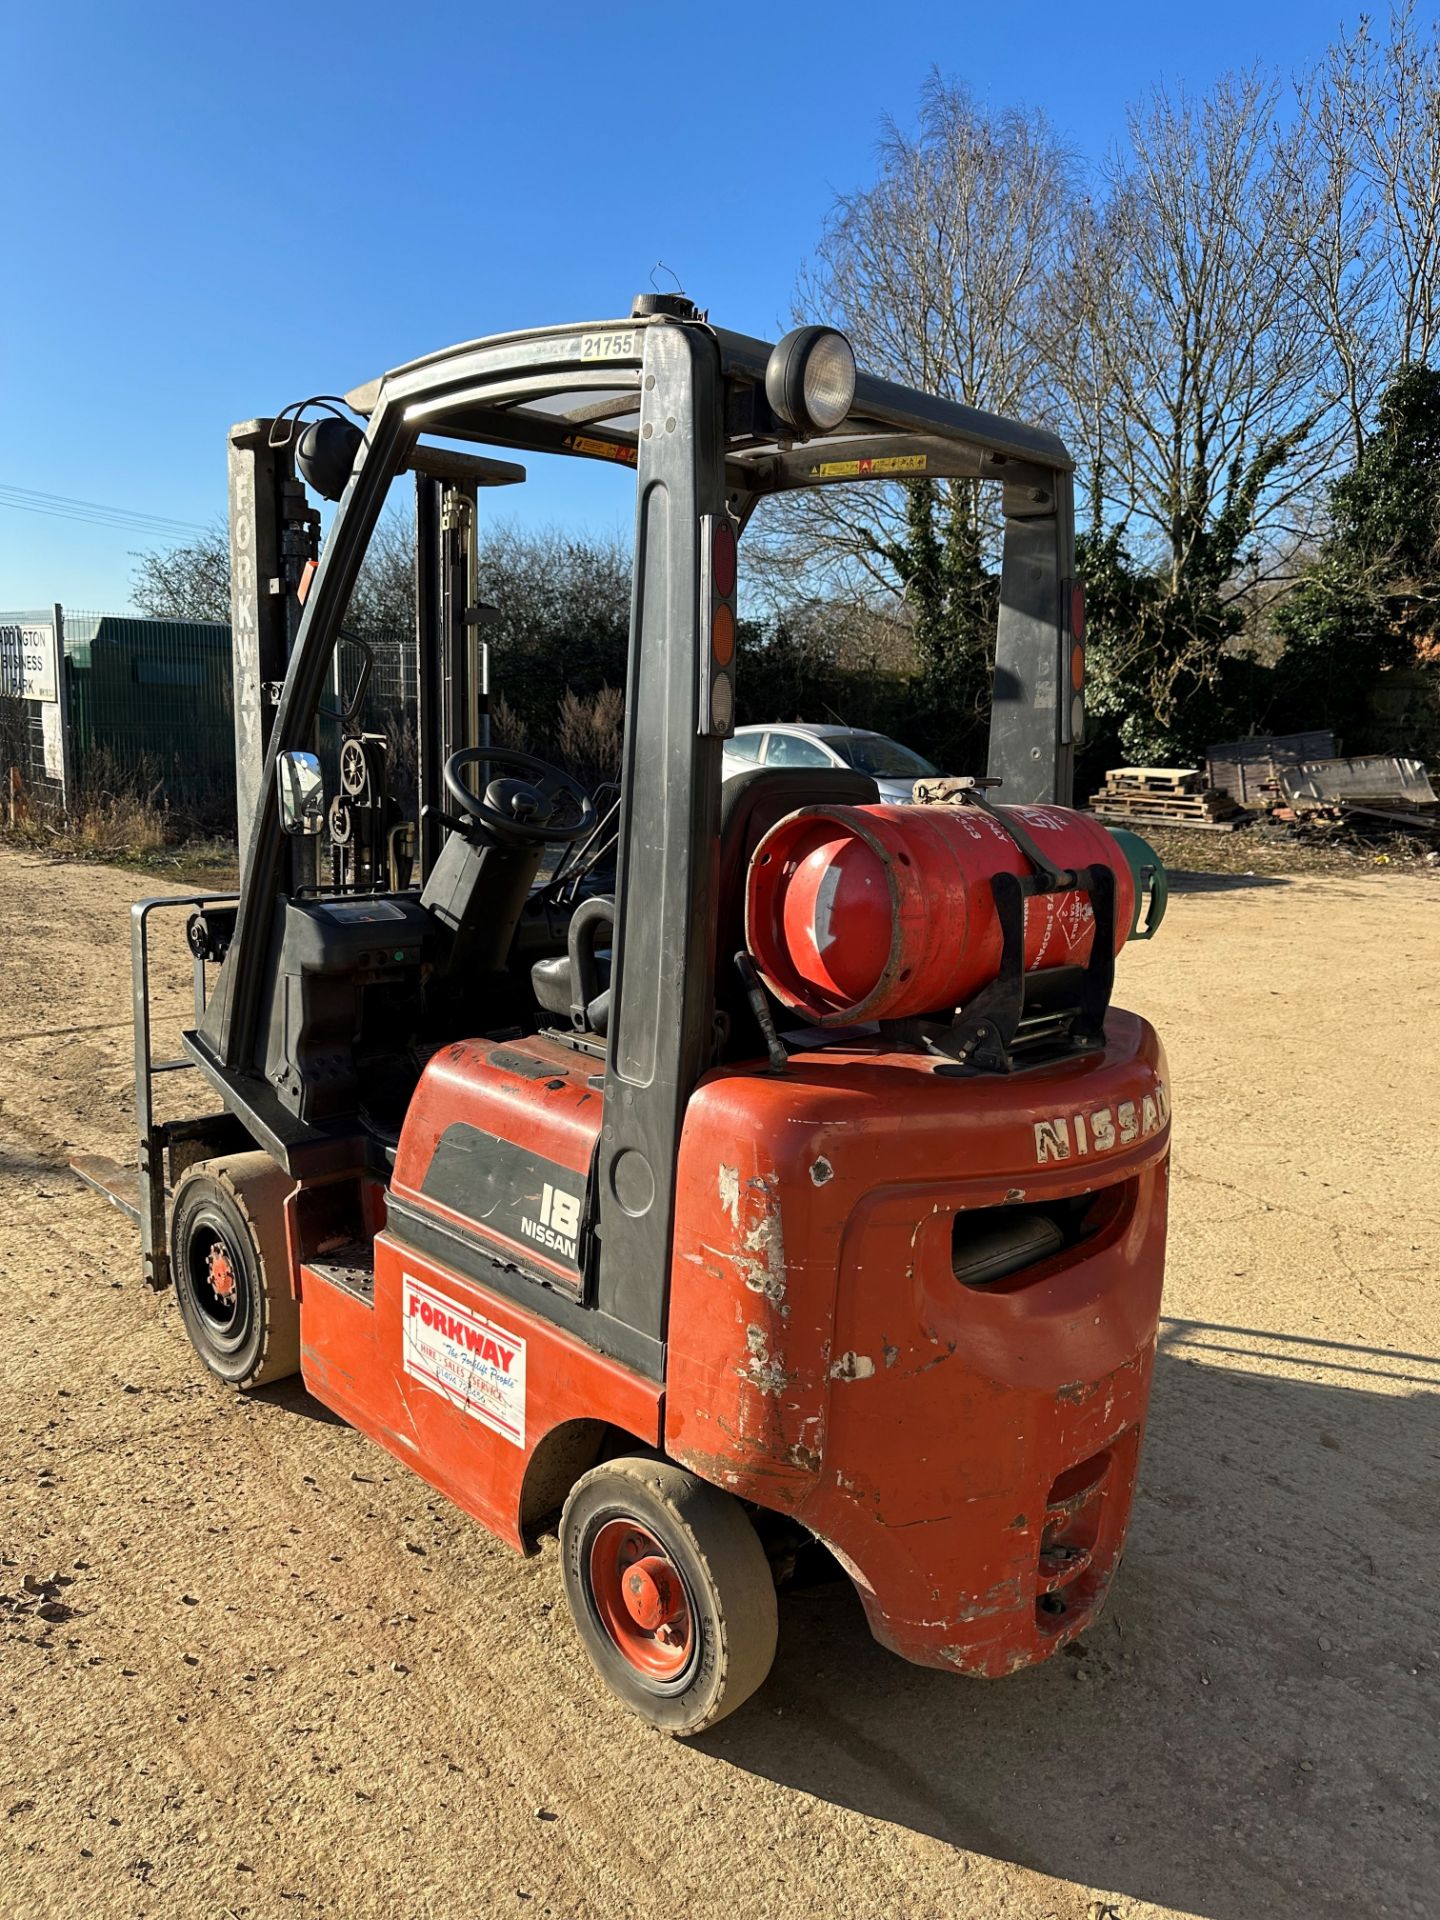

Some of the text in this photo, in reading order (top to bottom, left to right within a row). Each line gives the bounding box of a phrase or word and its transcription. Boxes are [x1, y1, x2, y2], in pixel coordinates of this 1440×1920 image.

[584, 335, 633, 357] 21755
[234, 473, 257, 745] FORKWAY
[2, 654, 43, 671] BUSINESS
[12, 678, 35, 694] PARK
[1070, 890, 1080, 940] LAMMABLE
[539, 1182, 581, 1239] 18
[521, 1216, 577, 1259] NISSAN
[409, 1294, 515, 1374] FORKWAY
[420, 1344, 504, 1402] HIRE SALES SERVICE
[460, 1353, 488, 1376] Forklift
